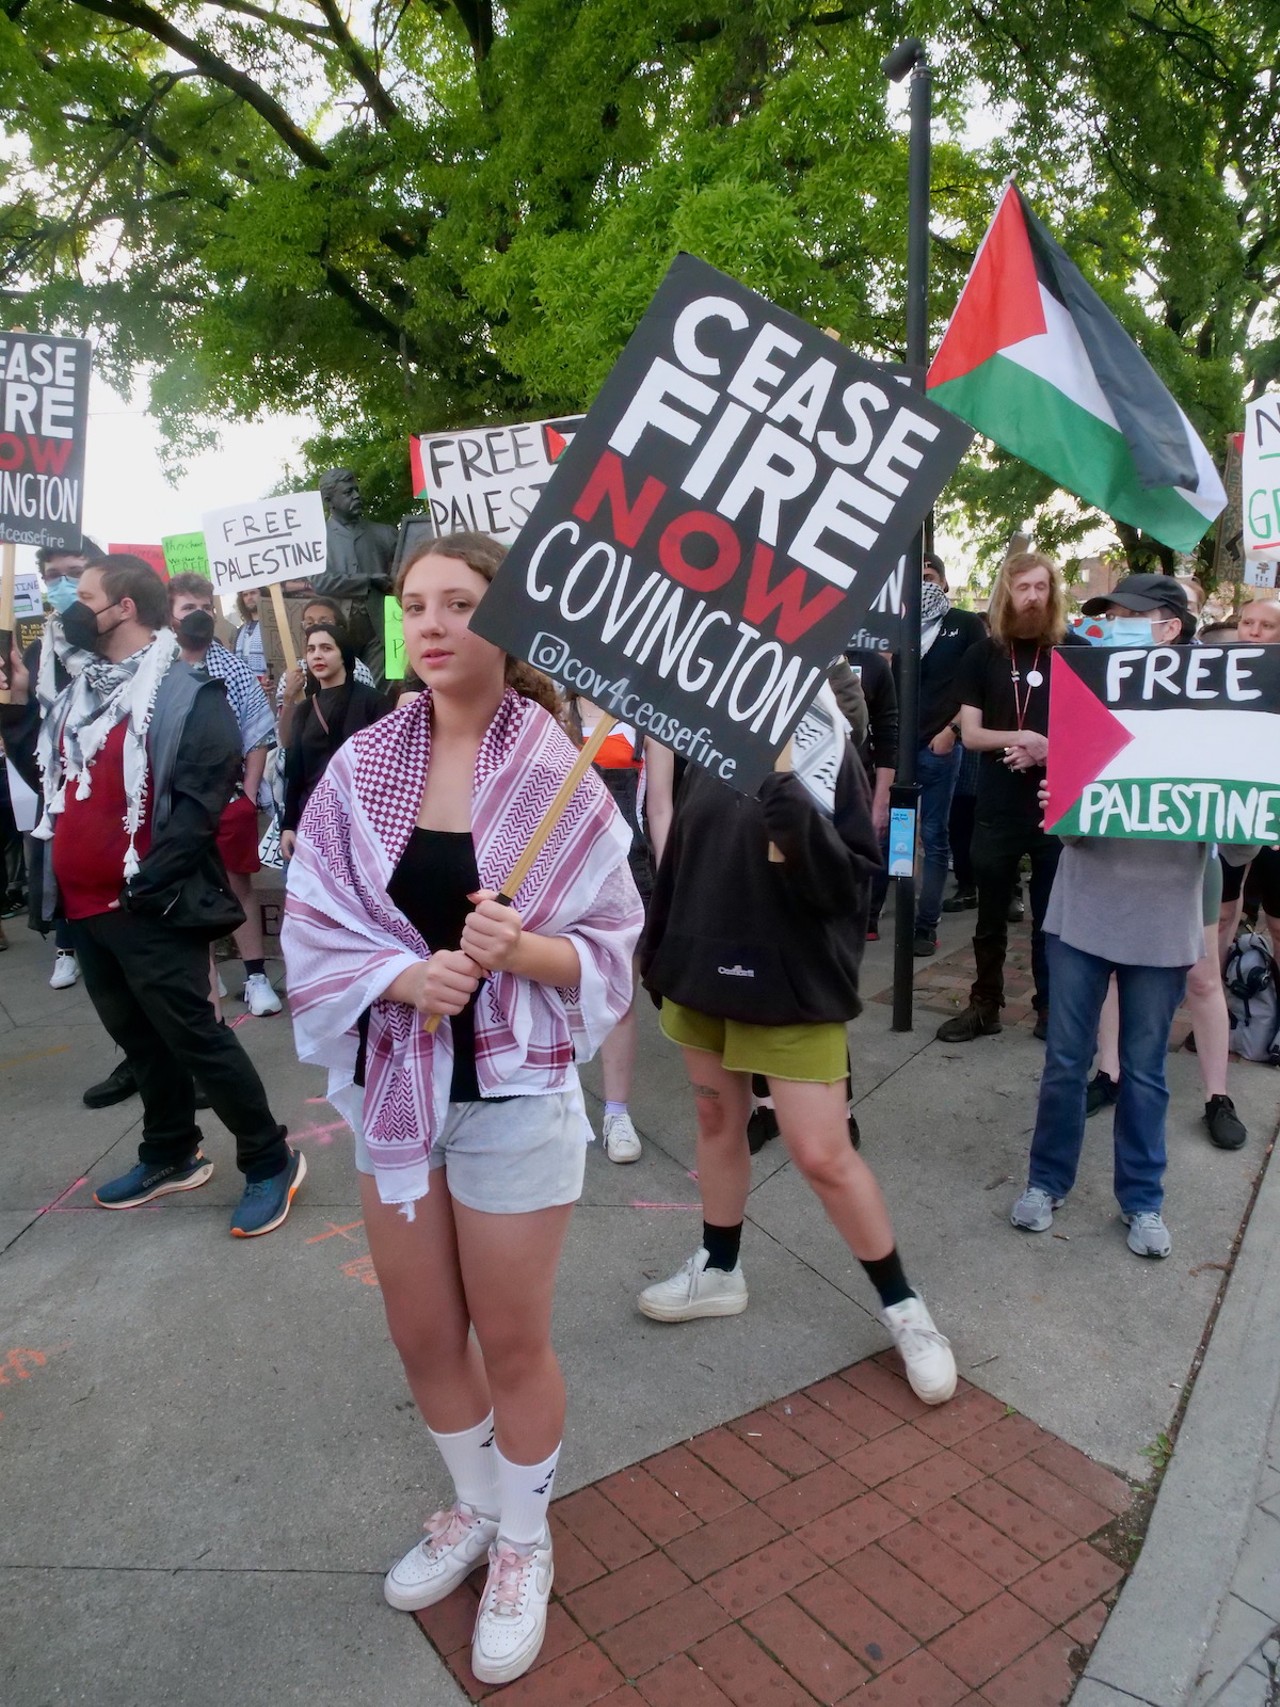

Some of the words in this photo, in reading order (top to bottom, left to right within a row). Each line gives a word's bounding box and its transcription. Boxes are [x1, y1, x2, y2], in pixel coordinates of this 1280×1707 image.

[673, 296, 941, 497] CEASE
[429, 426, 539, 489] FREE
[608, 356, 896, 589] FIRE
[222, 508, 302, 543] FREE
[572, 450, 846, 645] NOW
[213, 541, 325, 587] PALESTINE
[526, 520, 821, 745] COVINGTON
[1106, 647, 1266, 702] FREE
[1079, 782, 1280, 841] PALESTINE
